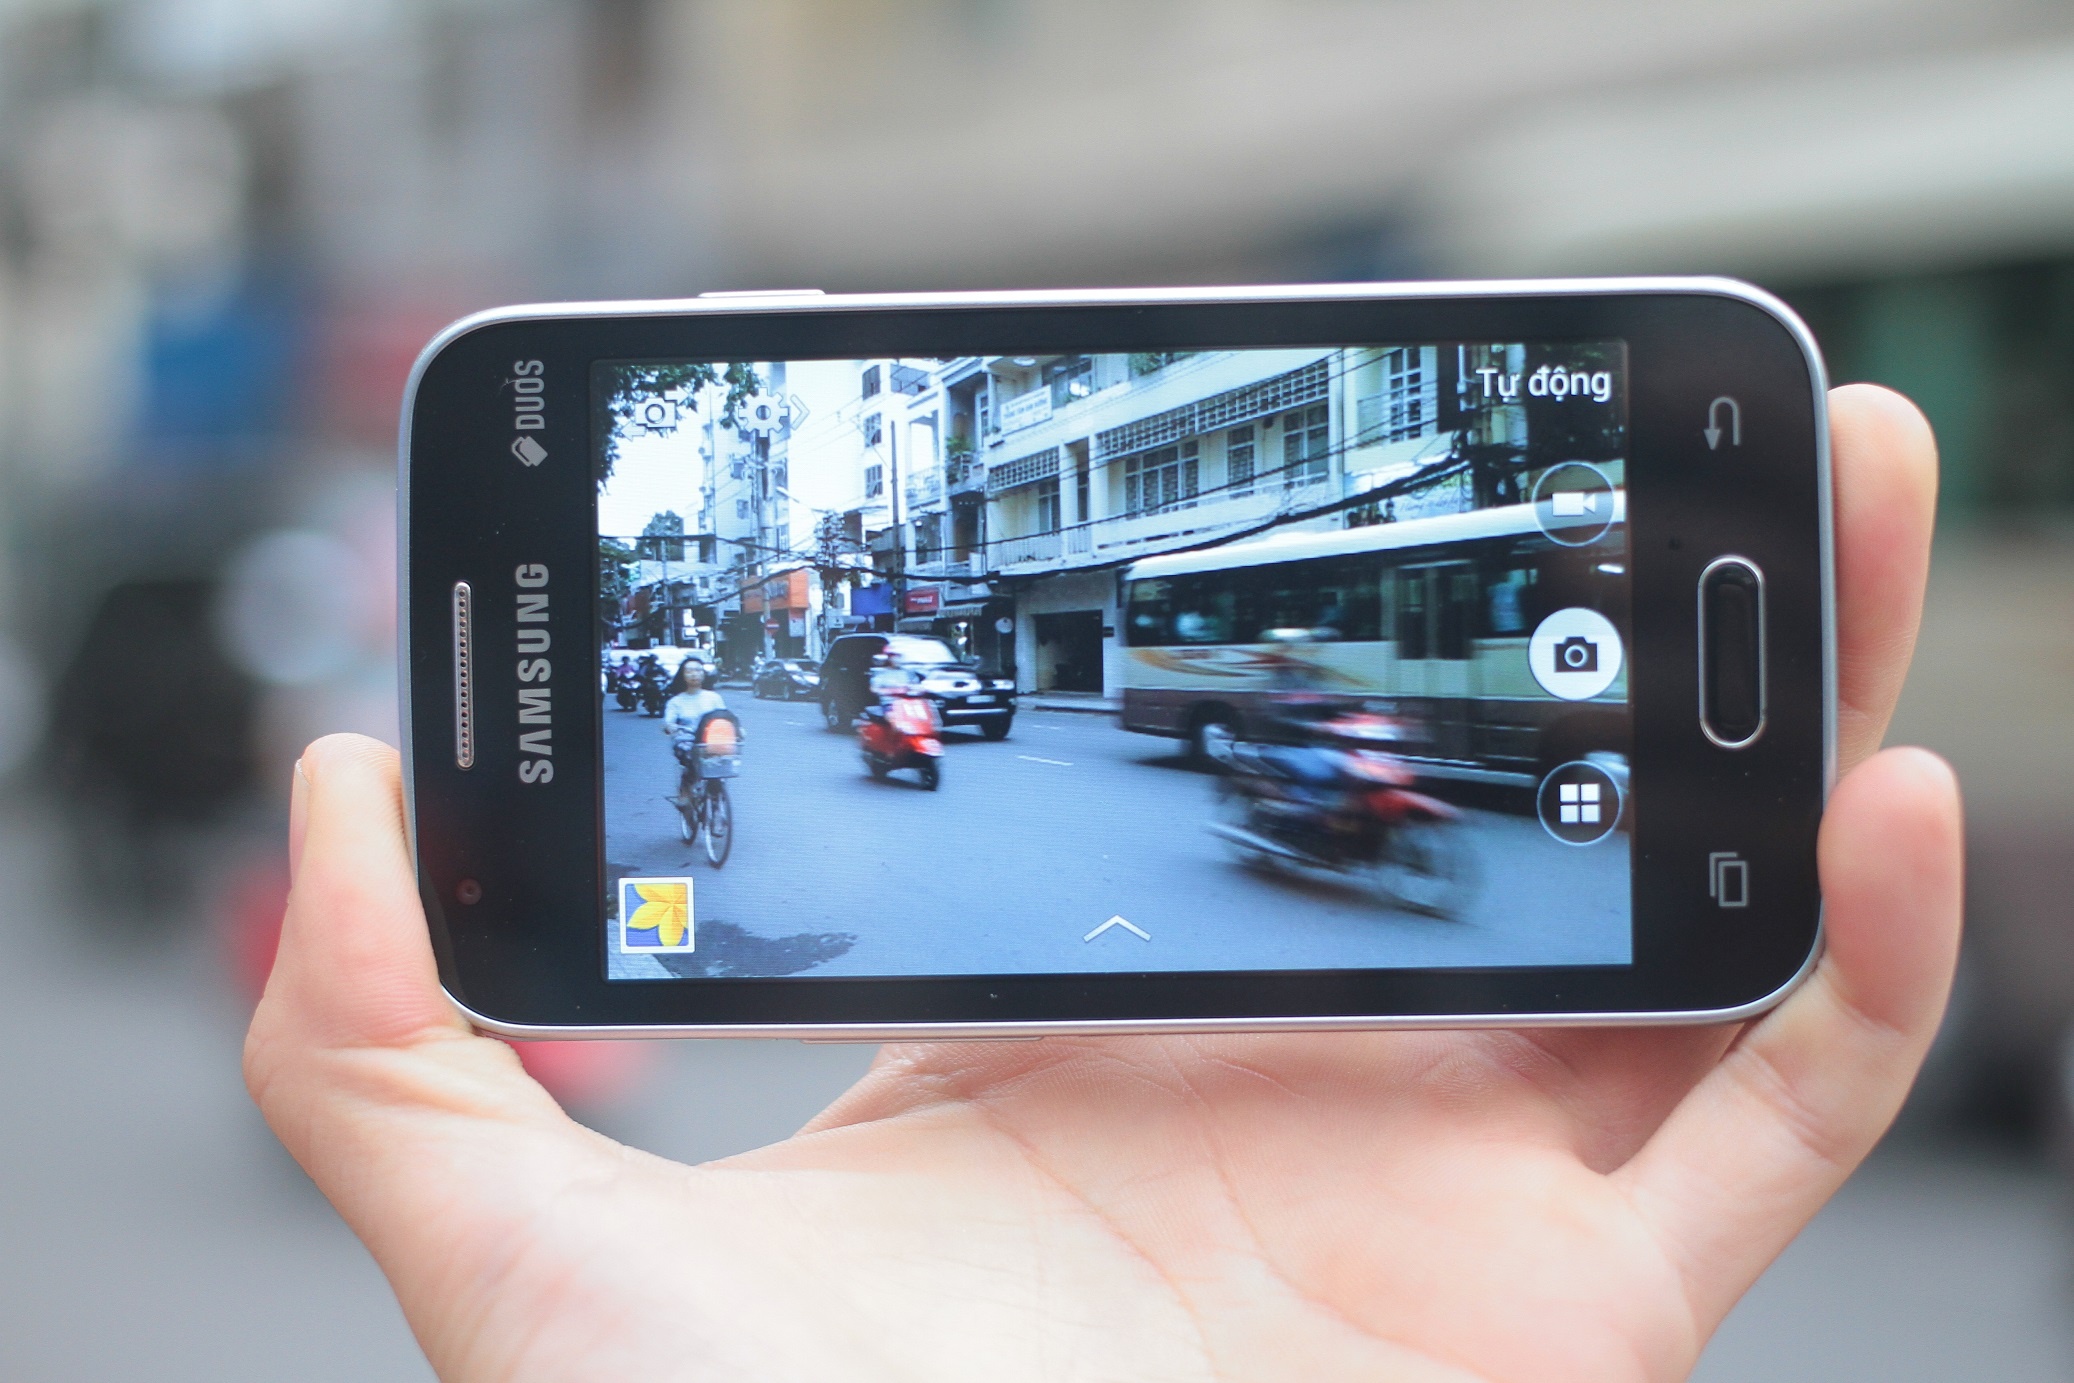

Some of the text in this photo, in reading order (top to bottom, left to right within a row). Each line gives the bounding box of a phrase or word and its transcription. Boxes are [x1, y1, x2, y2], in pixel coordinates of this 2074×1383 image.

[514, 360, 545, 430] DUOS
[1475, 364, 1613, 403] Tự động
[515, 563, 554, 785] SAMSUNG
